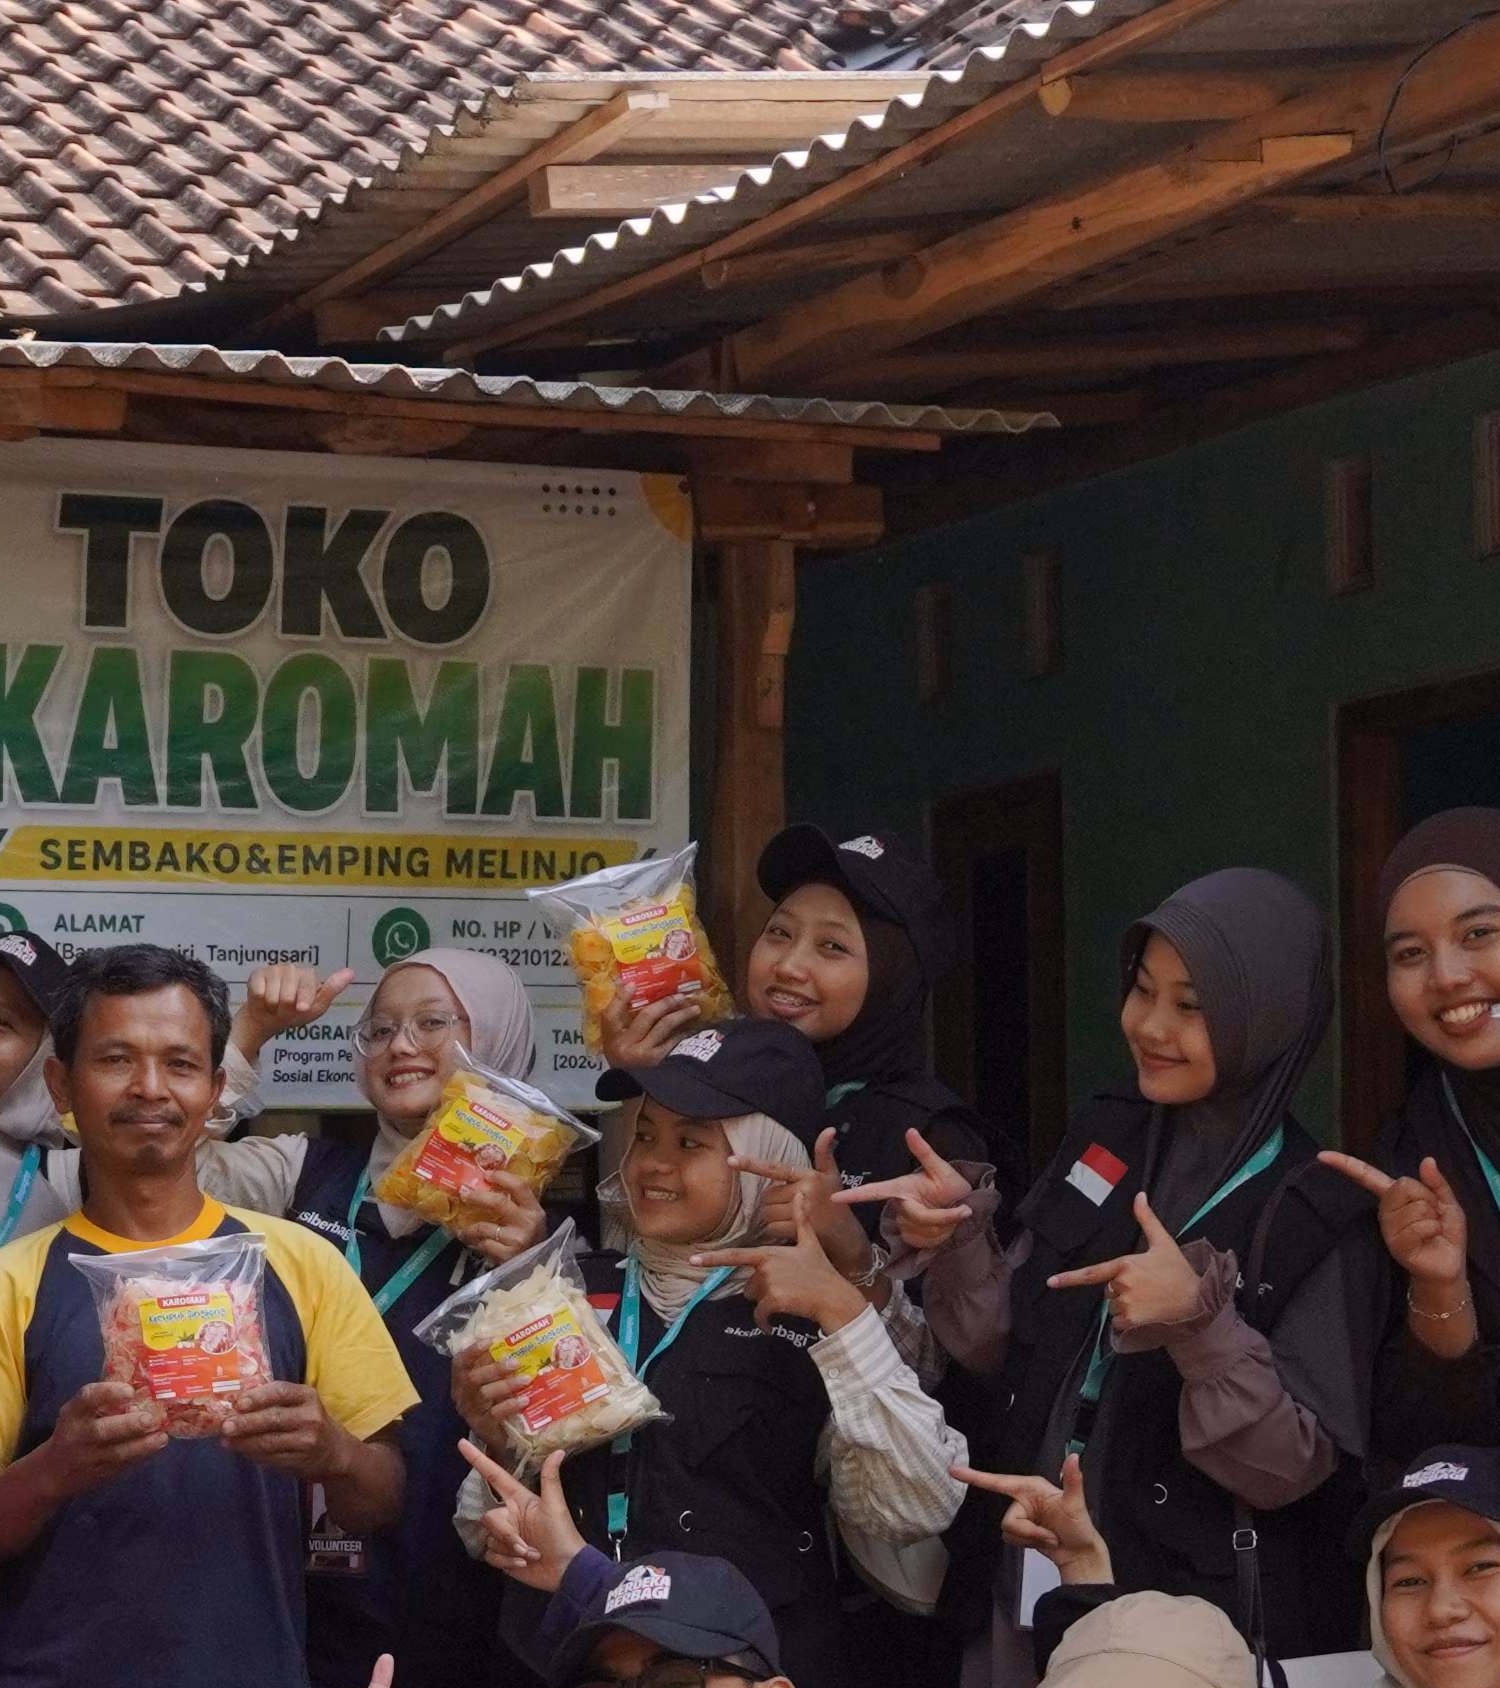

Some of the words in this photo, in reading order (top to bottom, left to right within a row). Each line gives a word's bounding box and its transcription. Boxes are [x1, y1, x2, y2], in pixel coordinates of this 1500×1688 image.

[60, 494, 487, 644] TOKO
[41, 839, 429, 878] SEMBAKO&EMPING
[446, 849, 605, 882] MELINJO
[54, 914, 145, 933] ALAMAT
[453, 920, 486, 938] NO.
[494, 920, 521, 939] HP
[207, 944, 320, 966] Tanjungsari]
[276, 1025, 353, 1041] PROGRA
[552, 1029, 584, 1045] TAH
[274, 1049, 334, 1065] [Program
[273, 1070, 312, 1083] Sosial
[470, 1103, 508, 1129] KAROMAH
[162, 1295, 206, 1307] KAROMAH
[509, 1317, 550, 1345] KAROMAH
[308, 1539, 362, 1552] VOLUNTEER
[607, 1576, 671, 1601] MERDEKA
[604, 1587, 669, 1615] BERBAGI
